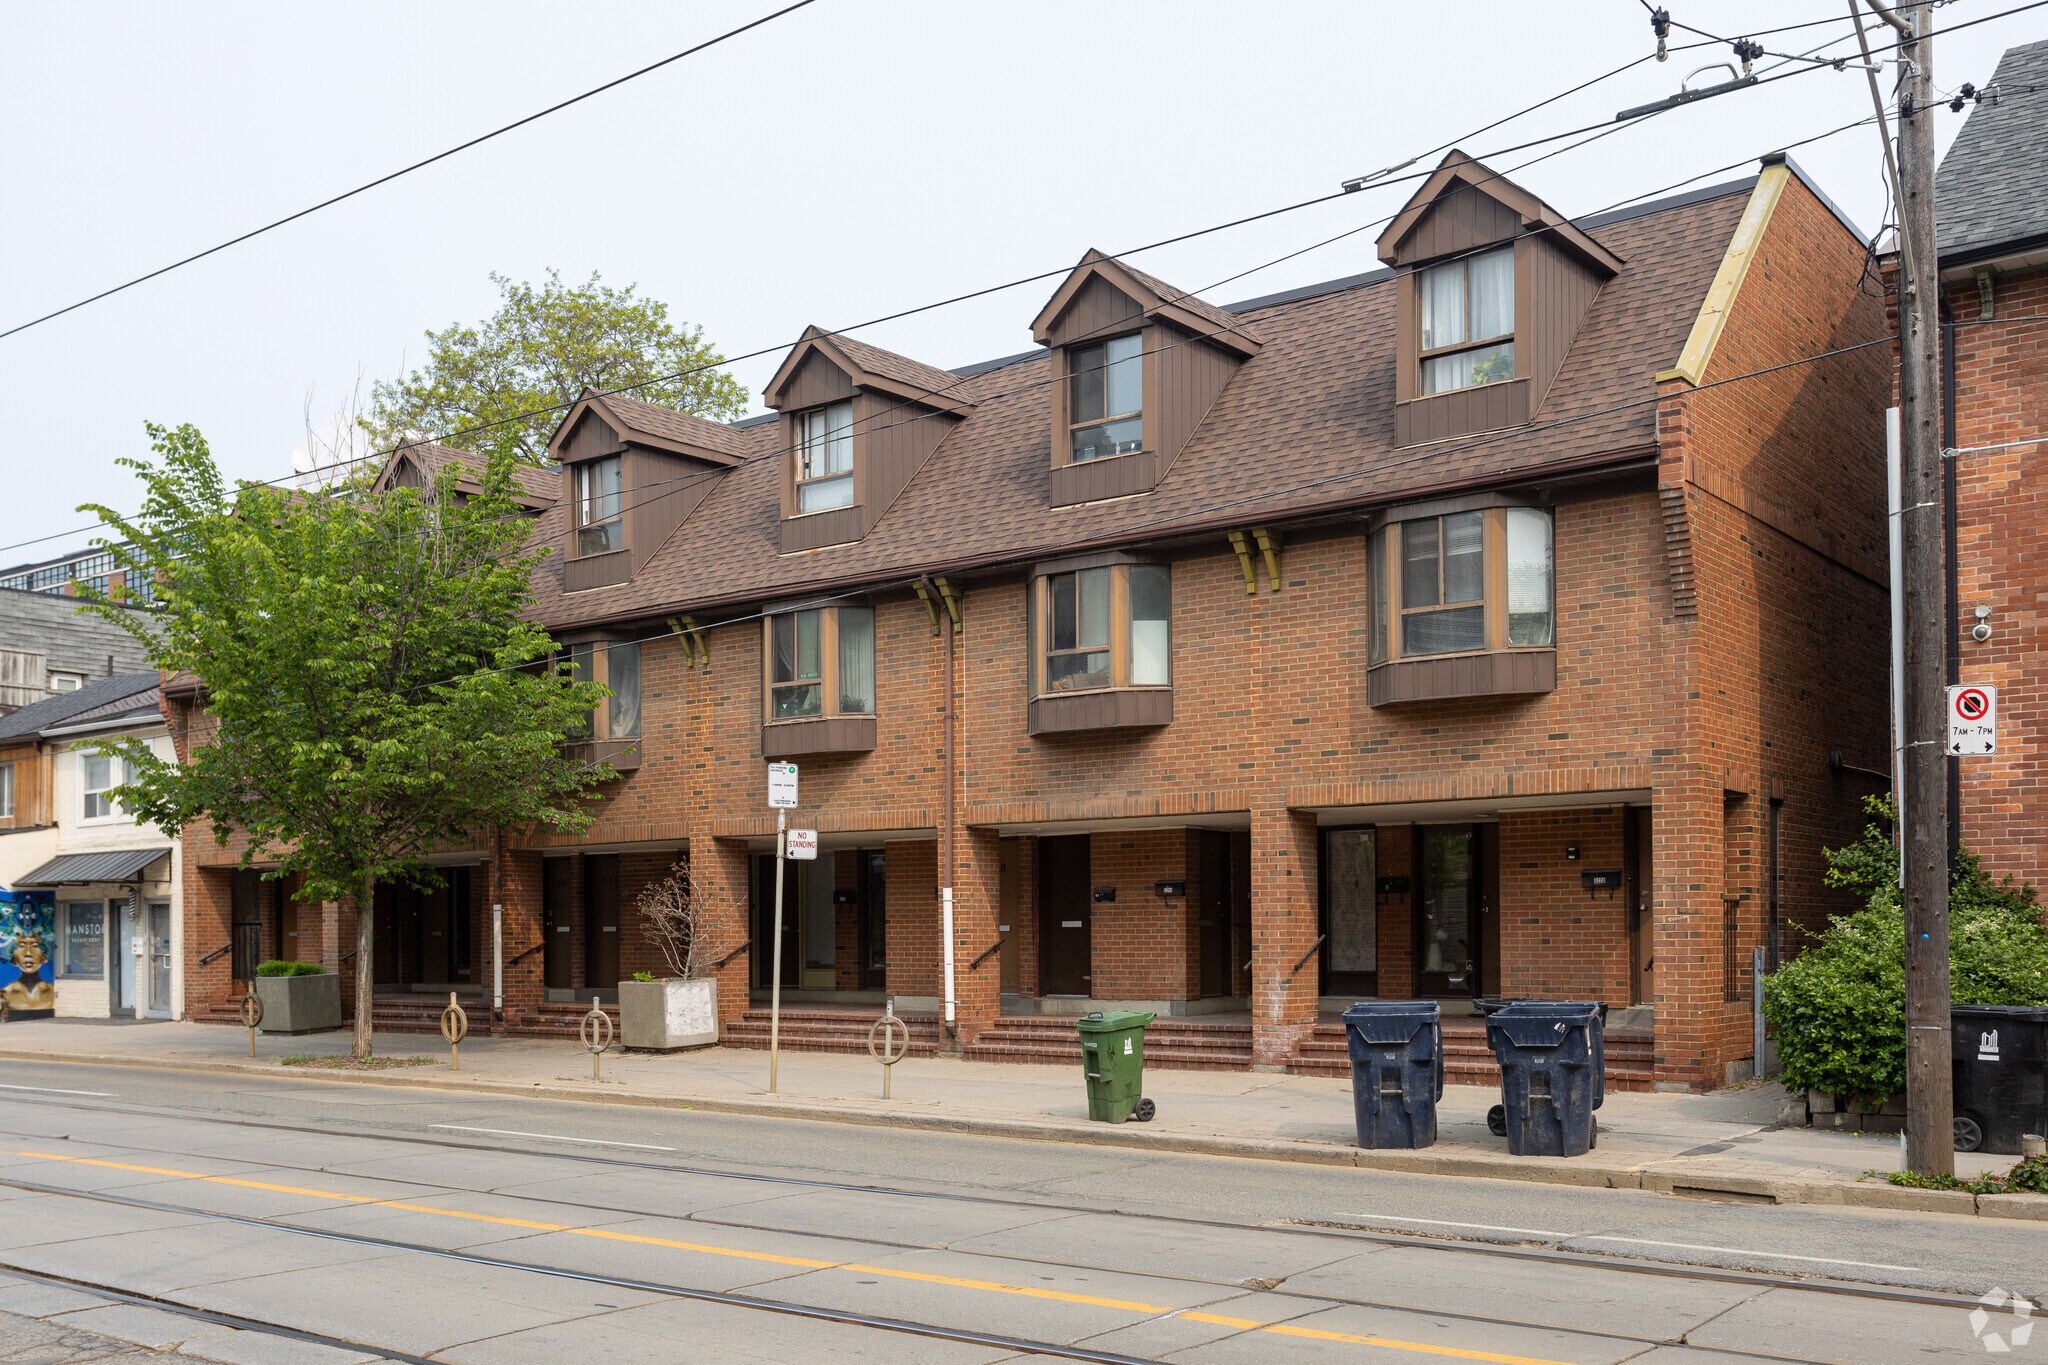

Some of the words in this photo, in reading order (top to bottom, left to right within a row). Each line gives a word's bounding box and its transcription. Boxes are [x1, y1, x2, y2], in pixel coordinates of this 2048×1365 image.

[1953, 726, 1968, 736] 7AM
[1977, 725, 1993, 735] 7PM
[788, 840, 816, 849] STANDING
